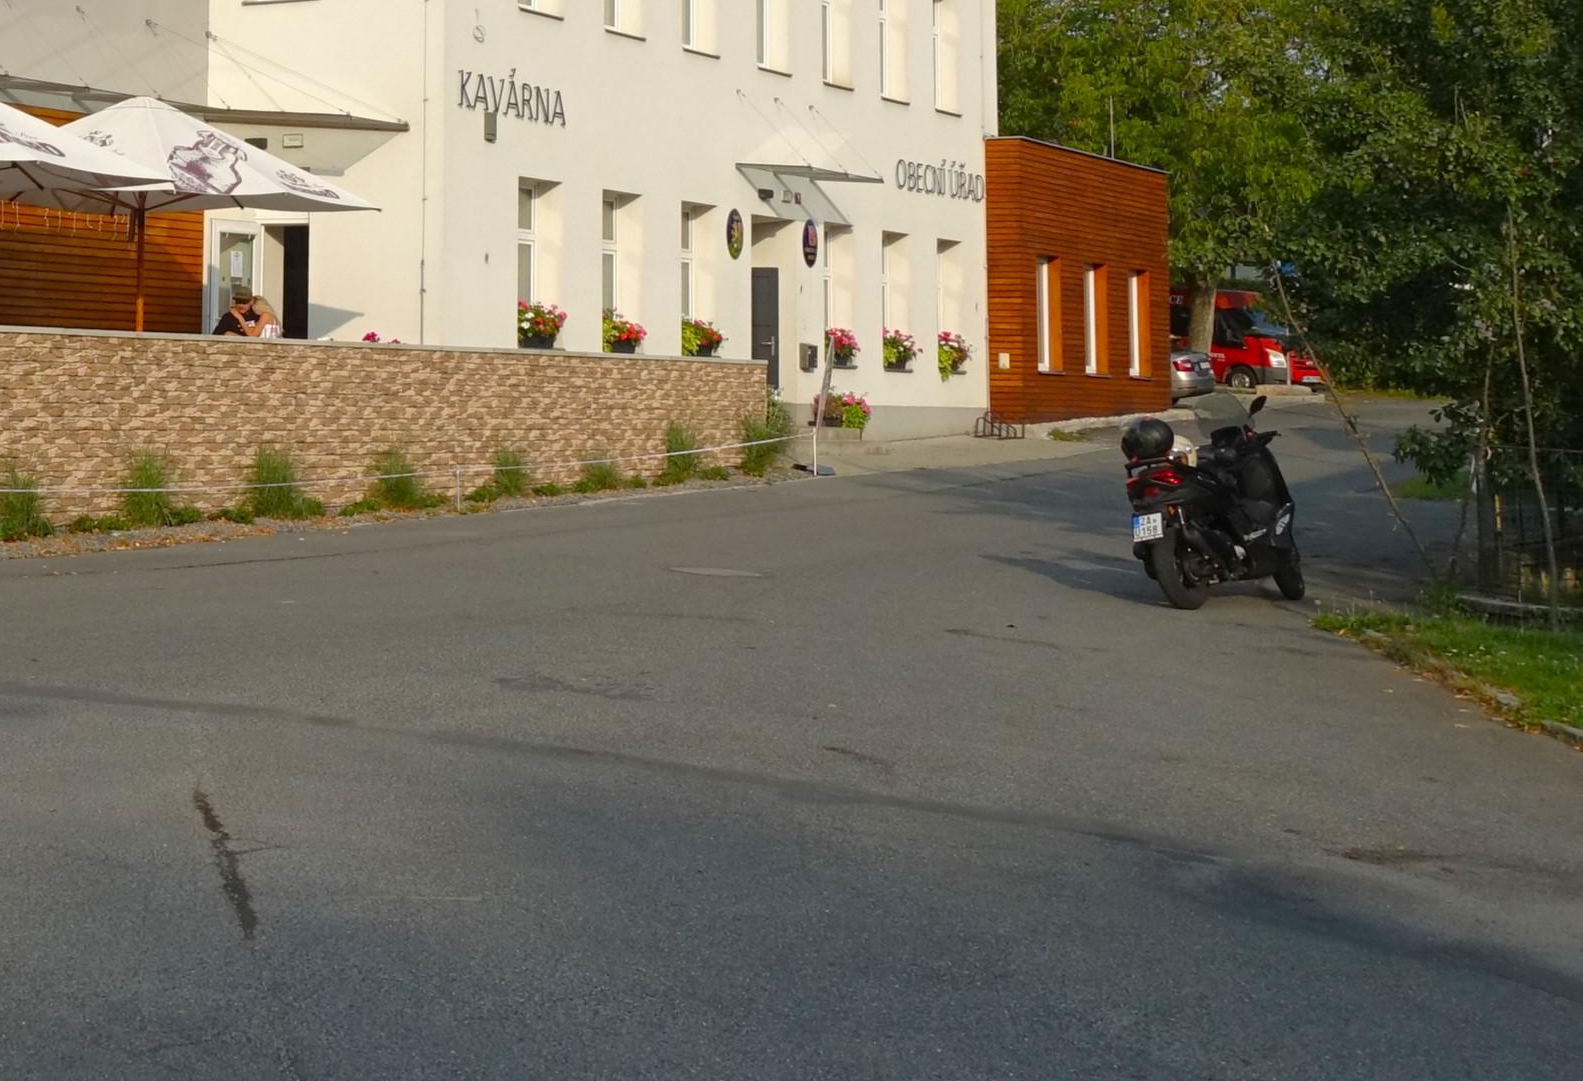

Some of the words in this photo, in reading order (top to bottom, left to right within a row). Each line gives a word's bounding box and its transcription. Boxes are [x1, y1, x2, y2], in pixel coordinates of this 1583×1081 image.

[458, 68, 566, 127] KAVÁRNA
[896, 159, 947, 196] OBECNÍ
[947, 160, 985, 203] ÚŘAD
